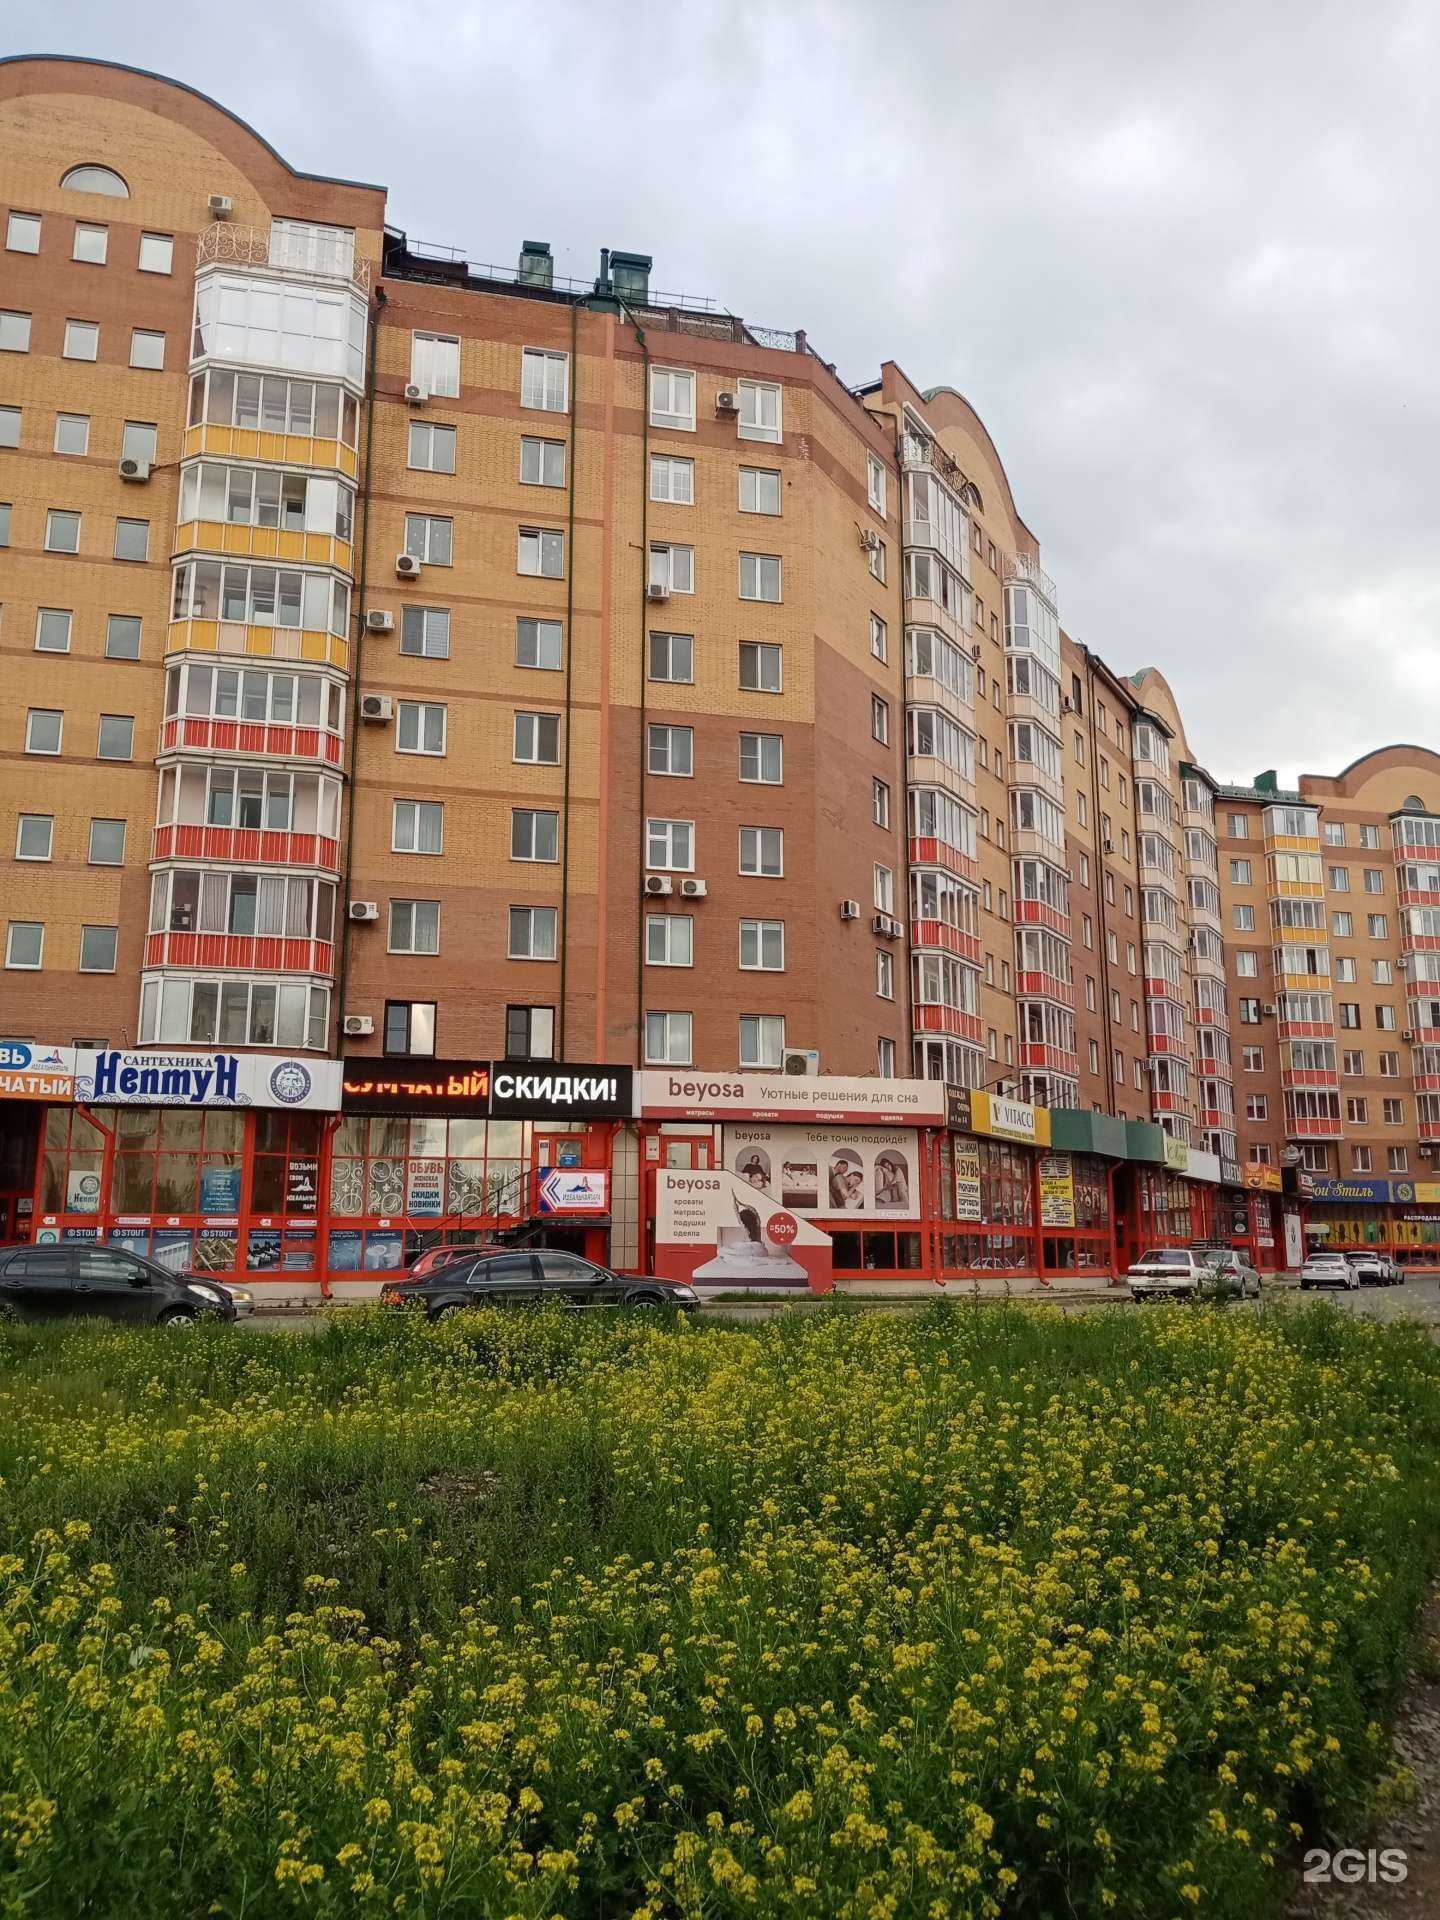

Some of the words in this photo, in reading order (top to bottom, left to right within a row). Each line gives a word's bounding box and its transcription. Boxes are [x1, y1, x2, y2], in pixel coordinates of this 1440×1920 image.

[123, 1055, 213, 1068] САНТЕХНИКА
[495, 1075, 617, 1104] СКИДКИ!
[669, 1077, 744, 1101] beyosa
[760, 1086, 809, 1100] Уютные
[812, 1090, 868, 1103] решения
[871, 1093, 894, 1104] для
[896, 1094, 919, 1103] сна
[686, 1109, 715, 1117] матрасы
[1004, 1105, 1034, 1129] VITACCI
[735, 1130, 771, 1142] beyosa
[805, 1132, 828, 1142] Тебе
[831, 1134, 859, 1143] точно
[289, 1162, 318, 1171] ВОЗЬМИ
[409, 1161, 444, 1174] ОБУВЬ
[956, 1158, 980, 1178] ОБУВЬ
[413, 1182, 439, 1190] МУЖСКАЯ
[667, 1176, 721, 1193] beyosa
[411, 1190, 440, 1199] СКИДКИ
[409, 1200, 441, 1209] НОВИНКИ
[673, 1209, 706, 1217] матрасы
[673, 1219, 706, 1228] подушки
[75, 1229, 98, 1238] STOU
[121, 1229, 145, 1238] STOUT
[210, 1230, 233, 1238] STOUT
[673, 1230, 700, 1238] одеяла
